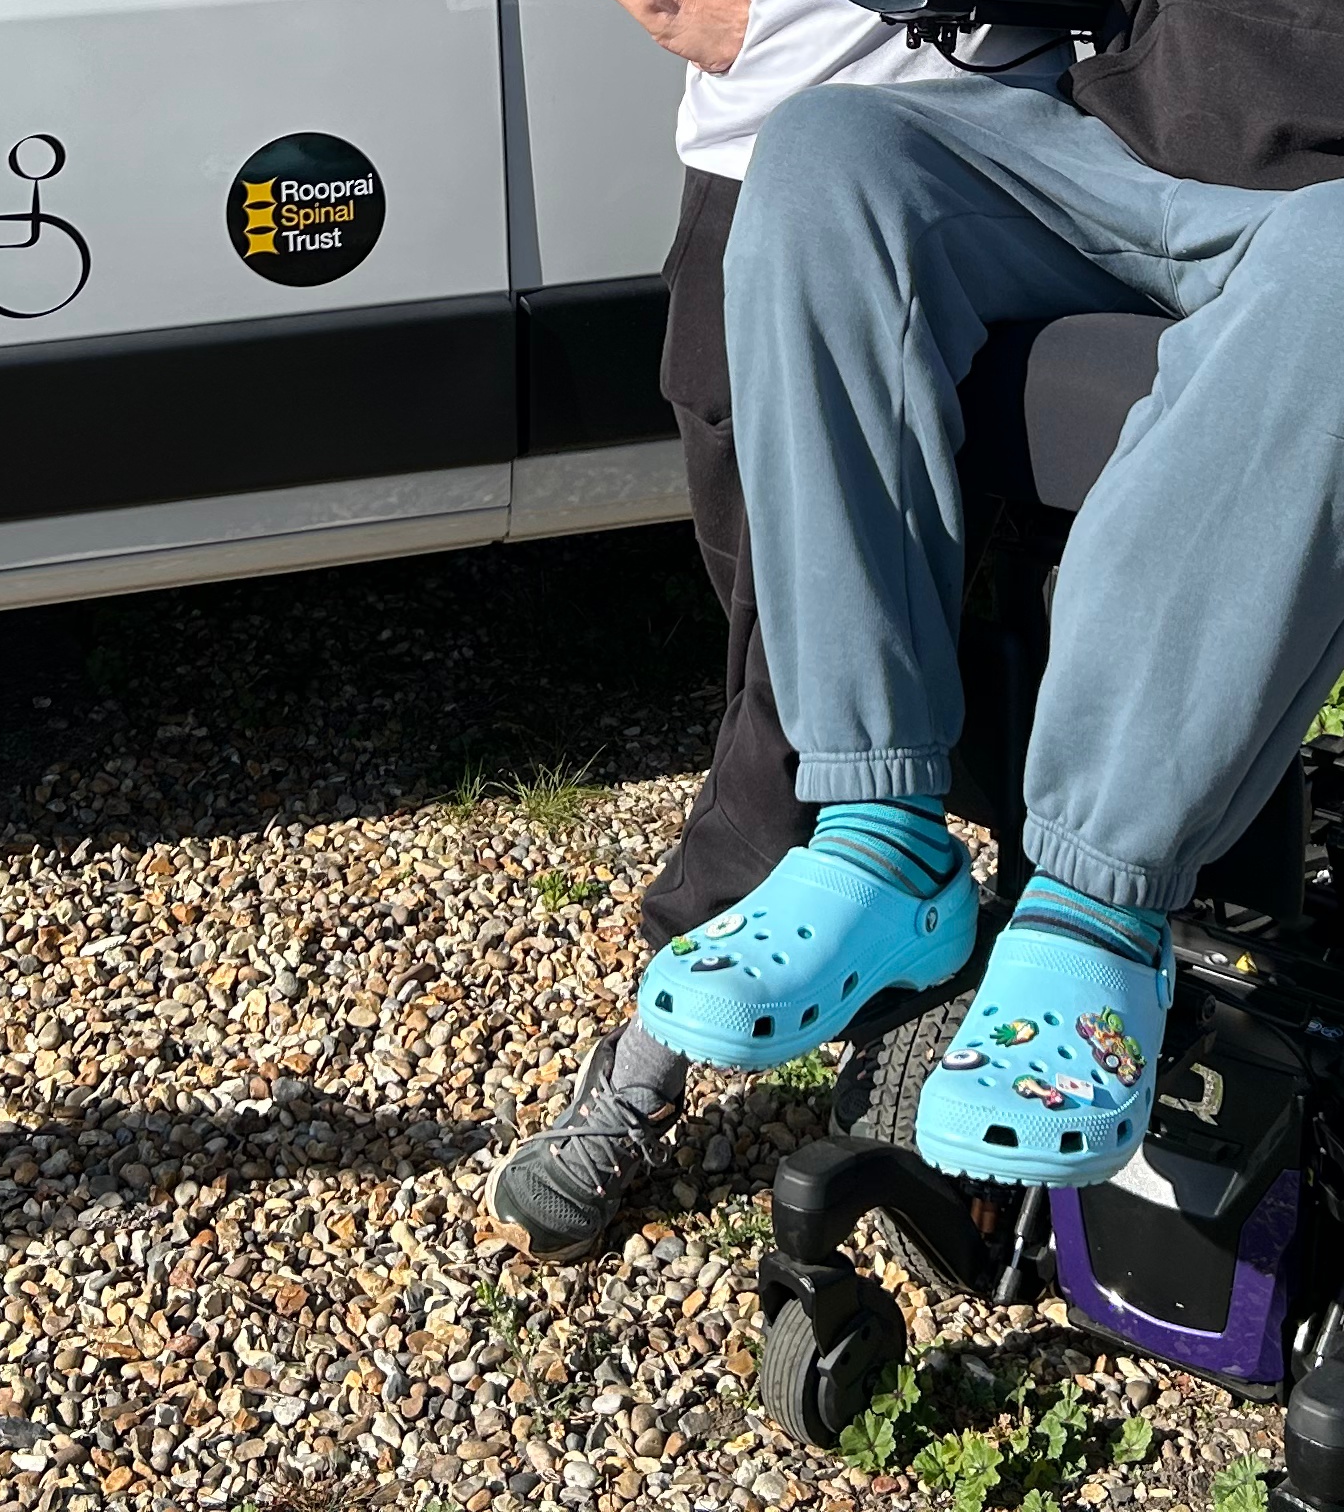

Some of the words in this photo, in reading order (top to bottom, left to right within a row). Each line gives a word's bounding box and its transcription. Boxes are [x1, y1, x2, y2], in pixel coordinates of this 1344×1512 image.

[281, 173, 374, 203] Rooprai
[281, 199, 354, 230] Spinal
[282, 227, 342, 252] Trust
